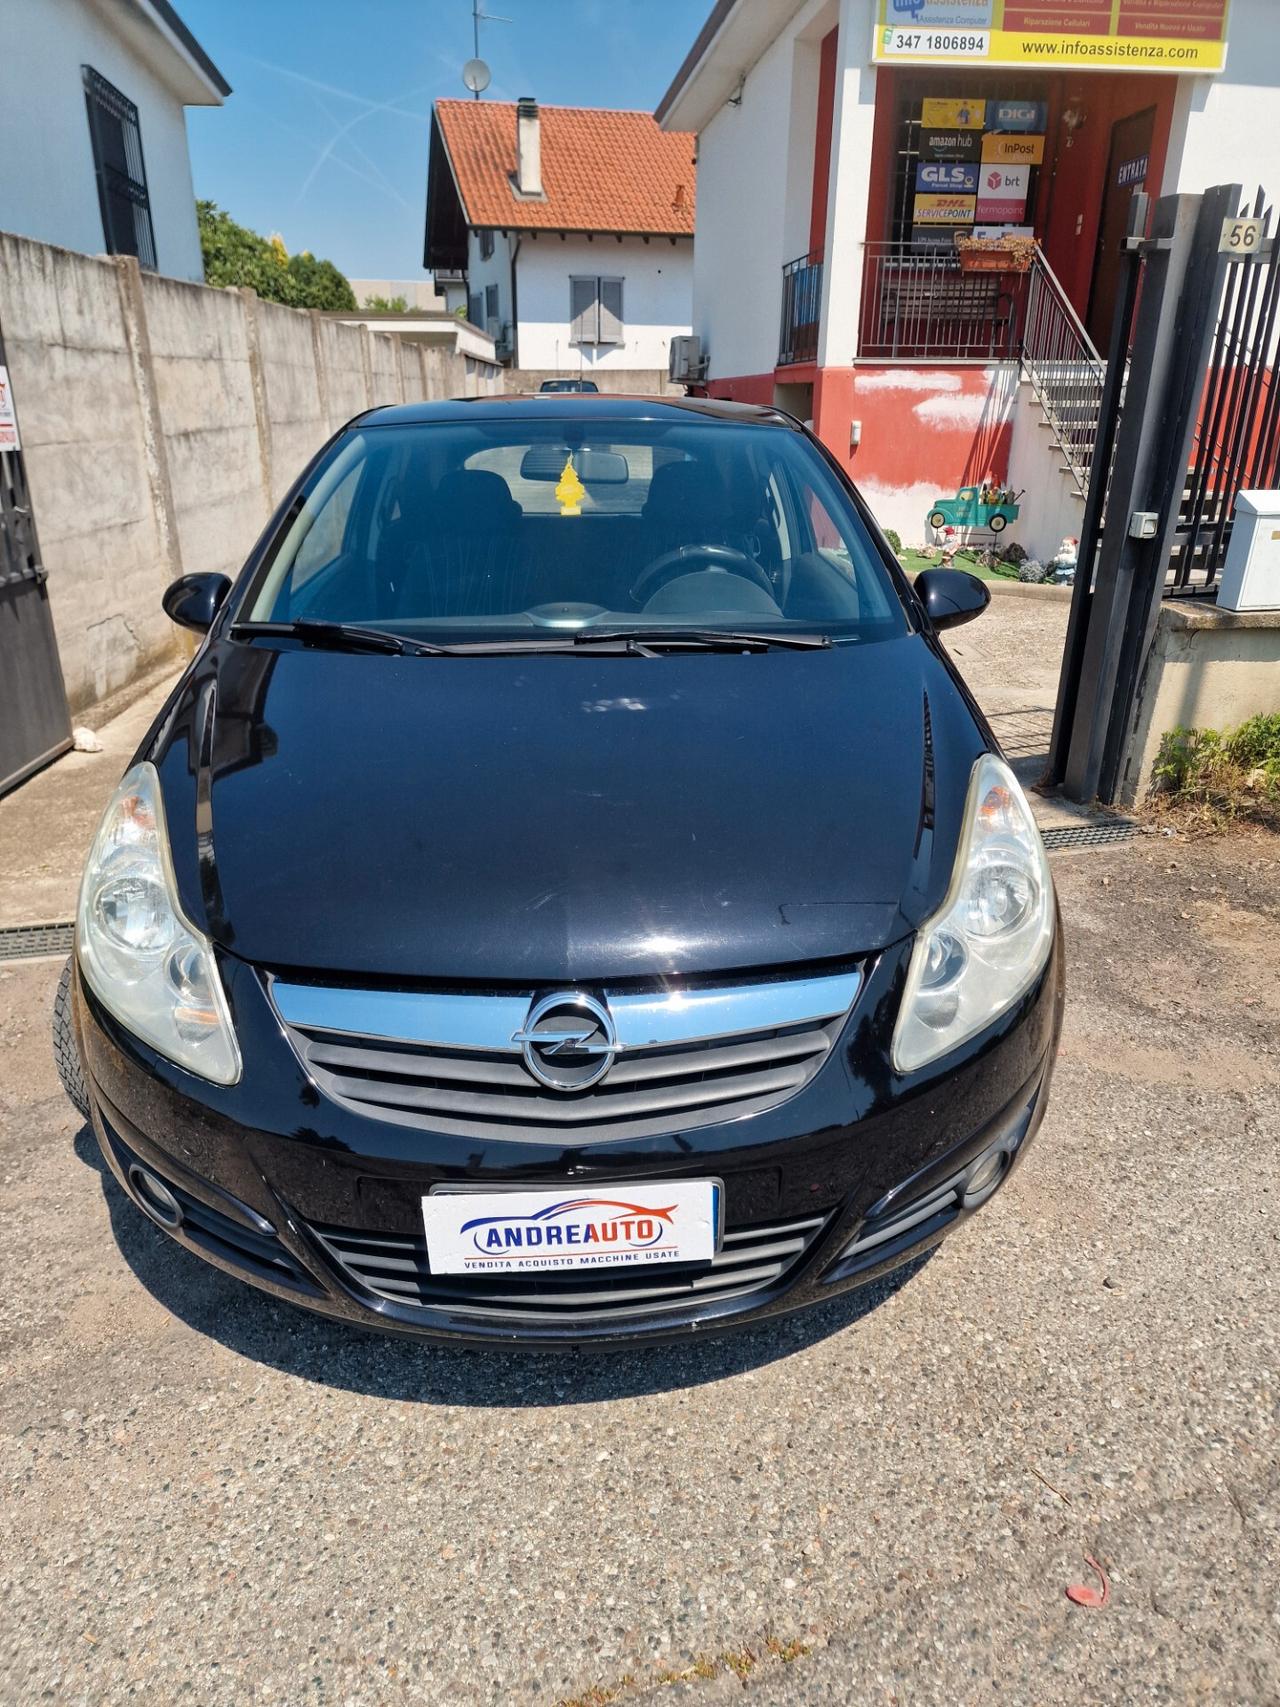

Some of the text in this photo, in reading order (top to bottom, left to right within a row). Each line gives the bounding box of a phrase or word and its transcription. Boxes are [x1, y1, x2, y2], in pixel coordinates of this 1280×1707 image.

[919, 15, 987, 25] Assistenza Computer
[896, 34, 984, 51] 347 1806894
[1022, 40, 1199, 59] www.infoassistenza.com
[998, 108, 1036, 120] DIGI
[929, 133, 973, 148] amazon hub
[1004, 143, 1035, 155] InPost
[921, 166, 965, 183] GLS
[1118, 157, 1149, 184] ENTRATA
[1004, 175, 1021, 187] brt
[936, 199, 967, 208] DHL
[917, 208, 972, 219] SERVICEPOINT
[1229, 224, 1257, 247] 56
[485, 1219, 655, 1249] ANDREAUTO
[464, 1250, 681, 1270] VENDITA ACQUISTO MACCHINE USATE
